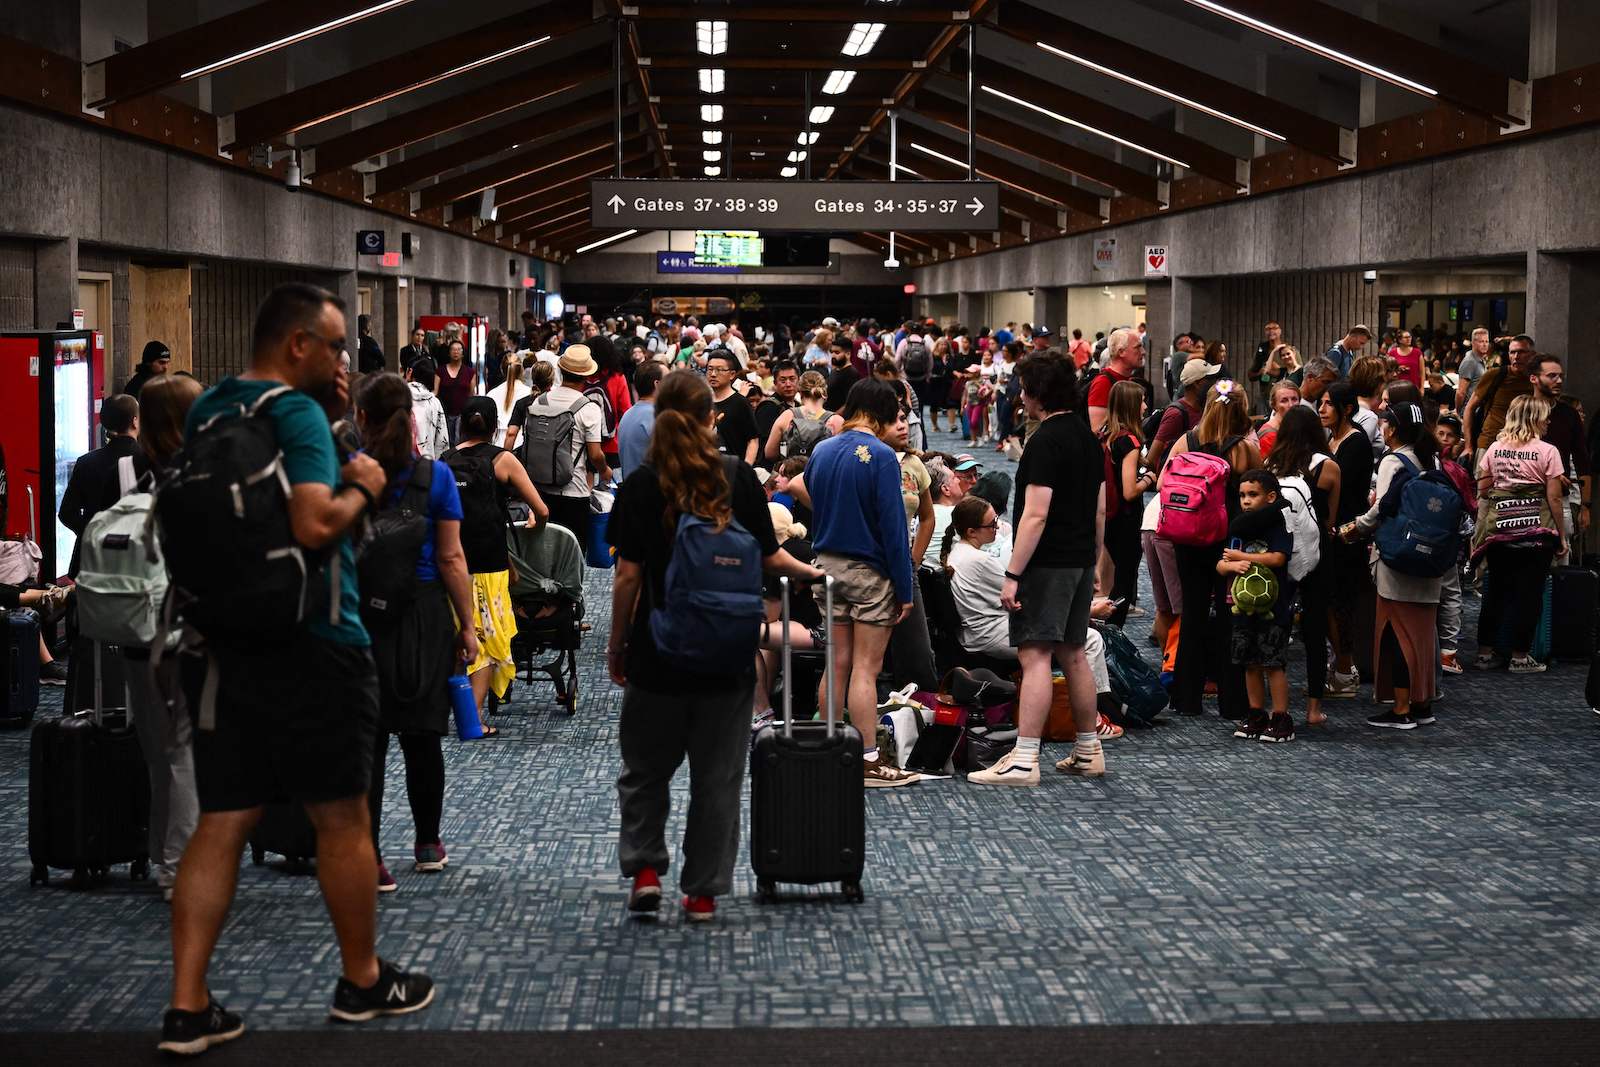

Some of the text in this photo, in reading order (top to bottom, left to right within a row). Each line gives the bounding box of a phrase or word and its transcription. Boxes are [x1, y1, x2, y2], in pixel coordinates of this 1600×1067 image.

[634, 198, 684, 211] Gates
[815, 199, 864, 212] Gates
[1495, 450, 1539, 461] BARBIE RULES
